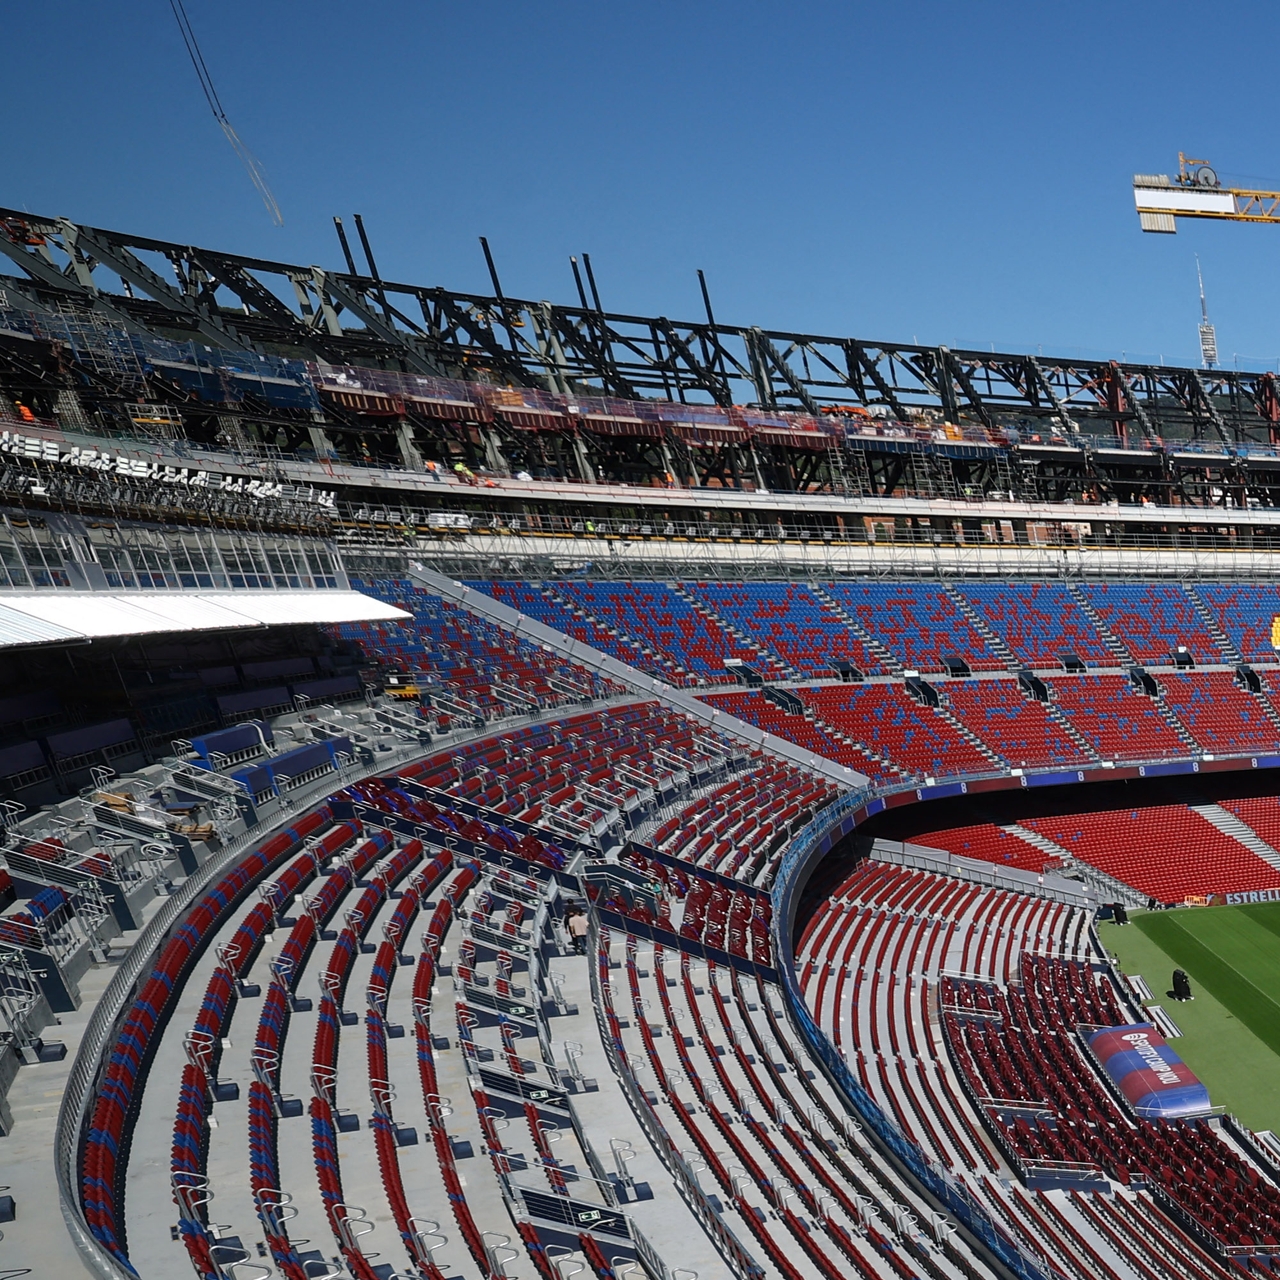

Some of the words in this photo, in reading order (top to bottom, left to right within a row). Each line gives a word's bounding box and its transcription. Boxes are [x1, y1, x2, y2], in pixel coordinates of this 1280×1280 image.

[1193, 762, 1199, 772] 8
[1252, 757, 1258, 768] 8
[1078, 771, 1085, 781] 8
[1139, 766, 1145, 777] 8
[1020, 776, 1027, 787] 8
[961, 782, 967, 793] 8
[1130, 1039, 1160, 1058] SPOTIFY
[1145, 1058, 1171, 1072] CAMP
[1156, 1071, 1181, 1085] NOU
